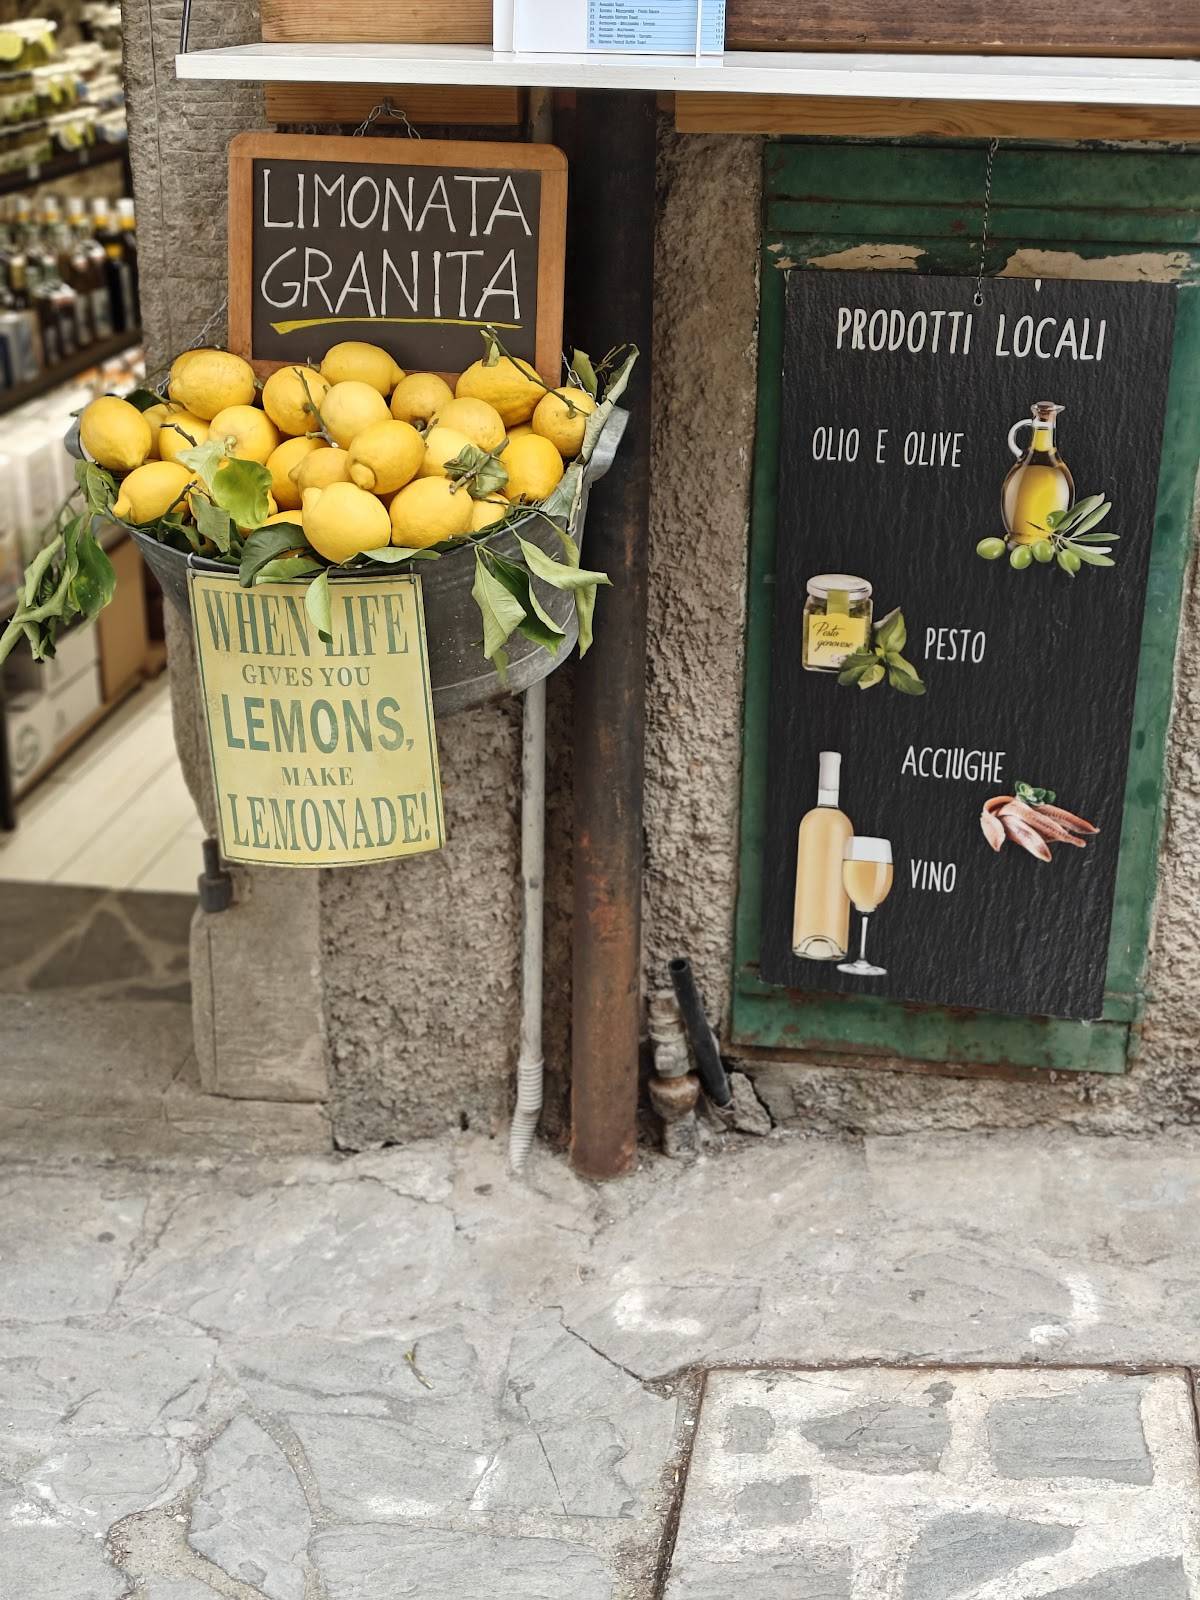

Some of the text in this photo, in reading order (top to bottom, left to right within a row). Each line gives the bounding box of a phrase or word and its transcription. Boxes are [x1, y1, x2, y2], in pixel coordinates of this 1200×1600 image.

[264, 169, 533, 236] LIMONATA
[260, 247, 521, 319] GRANITA
[836, 308, 1107, 361] PRODOTTI LOCALI
[812, 426, 965, 468] OLIO E OLIVE
[202, 589, 311, 657] WHEN
[812, 621, 844, 636] Pesto
[924, 627, 986, 664] PESTO
[242, 664, 371, 687] GIVES YOU
[221, 694, 415, 754] LEMONS,
[281, 766, 354, 787] MAKE
[901, 746, 1006, 784] ACCIUGHE
[227, 791, 431, 852] LEMONADE!
[910, 858, 957, 893] VINO
